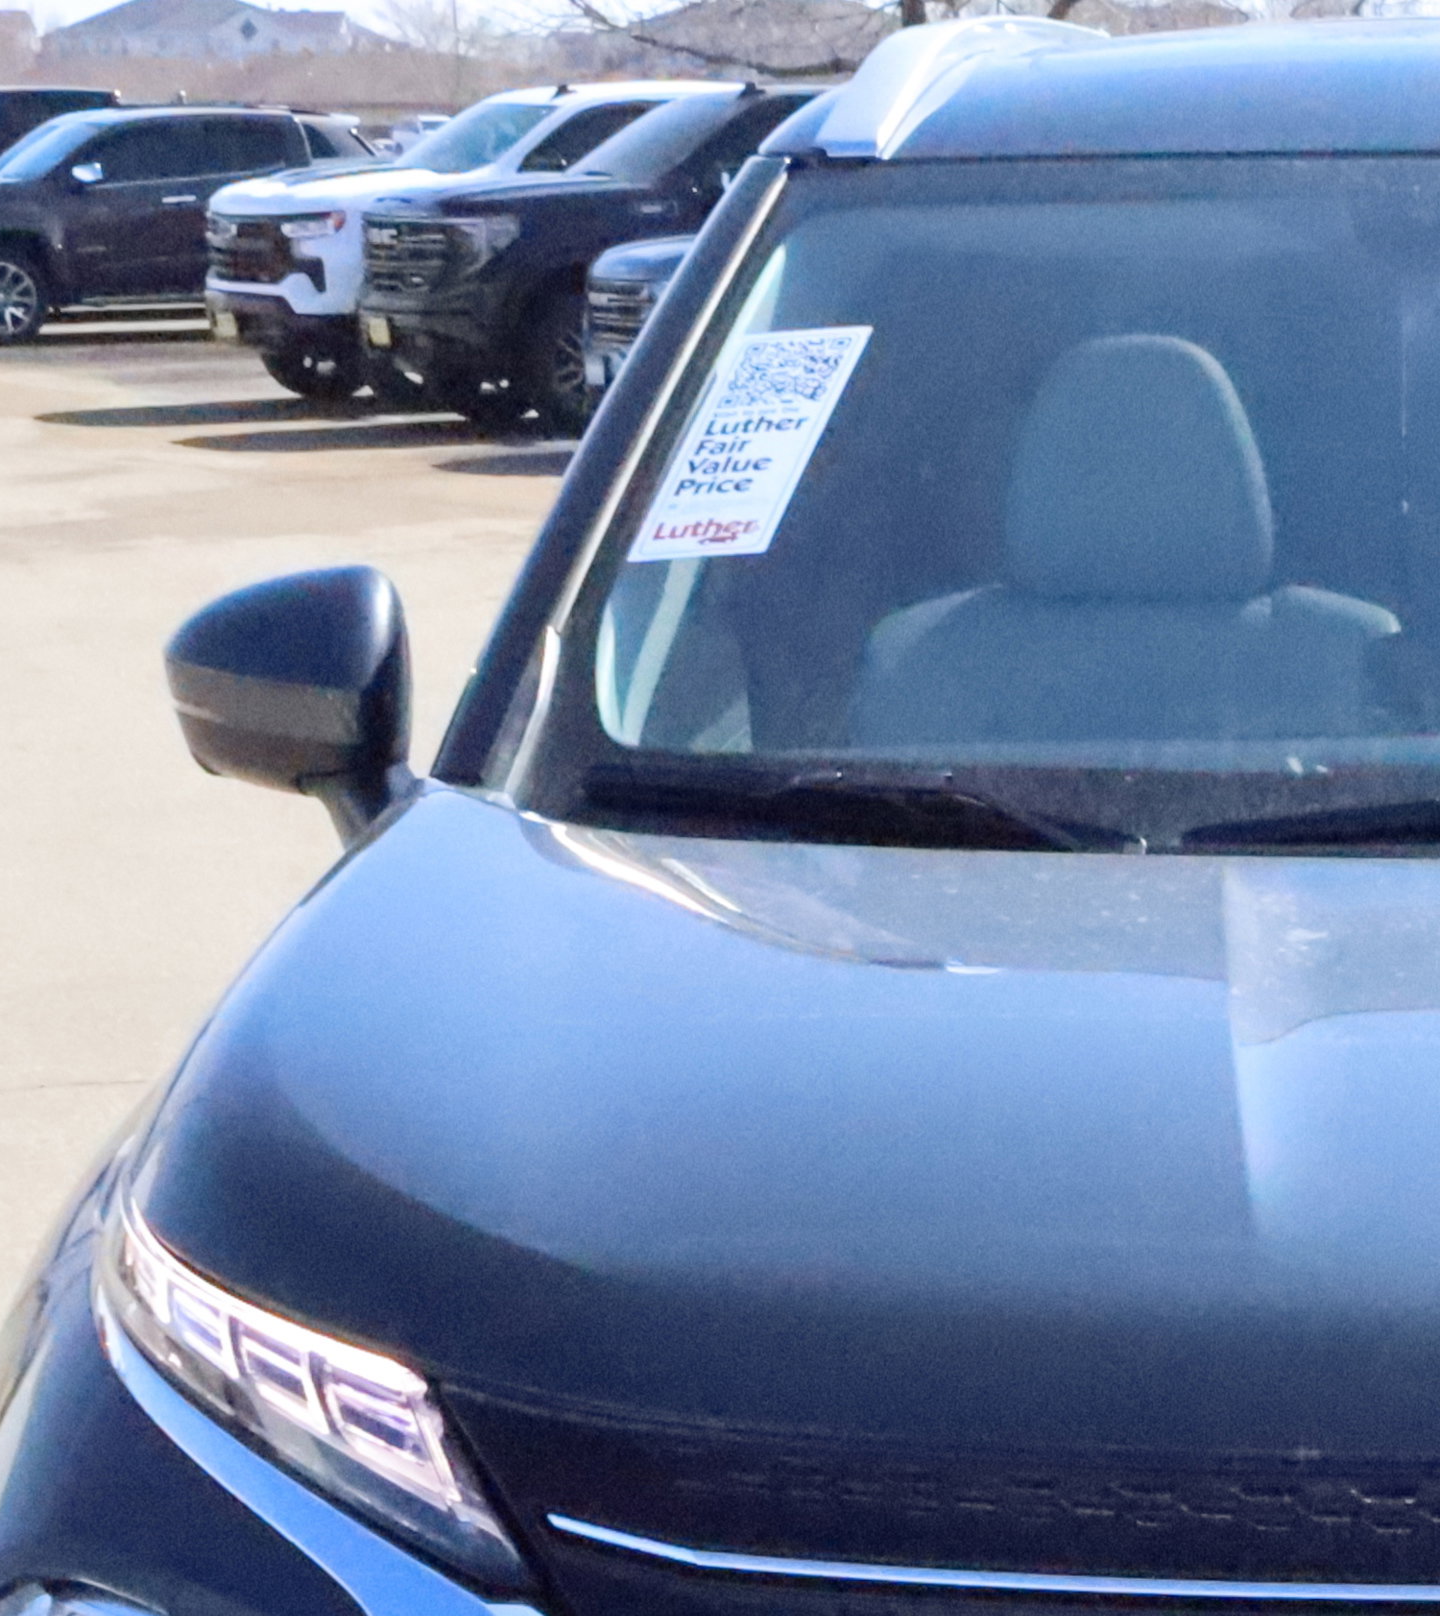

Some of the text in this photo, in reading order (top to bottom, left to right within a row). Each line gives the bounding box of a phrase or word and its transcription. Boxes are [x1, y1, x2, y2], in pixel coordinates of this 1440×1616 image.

[705, 416, 808, 436] Luther
[694, 436, 750, 457] Fair
[688, 456, 772, 474] Value
[674, 477, 753, 496] Price
[653, 519, 760, 541] Luther
